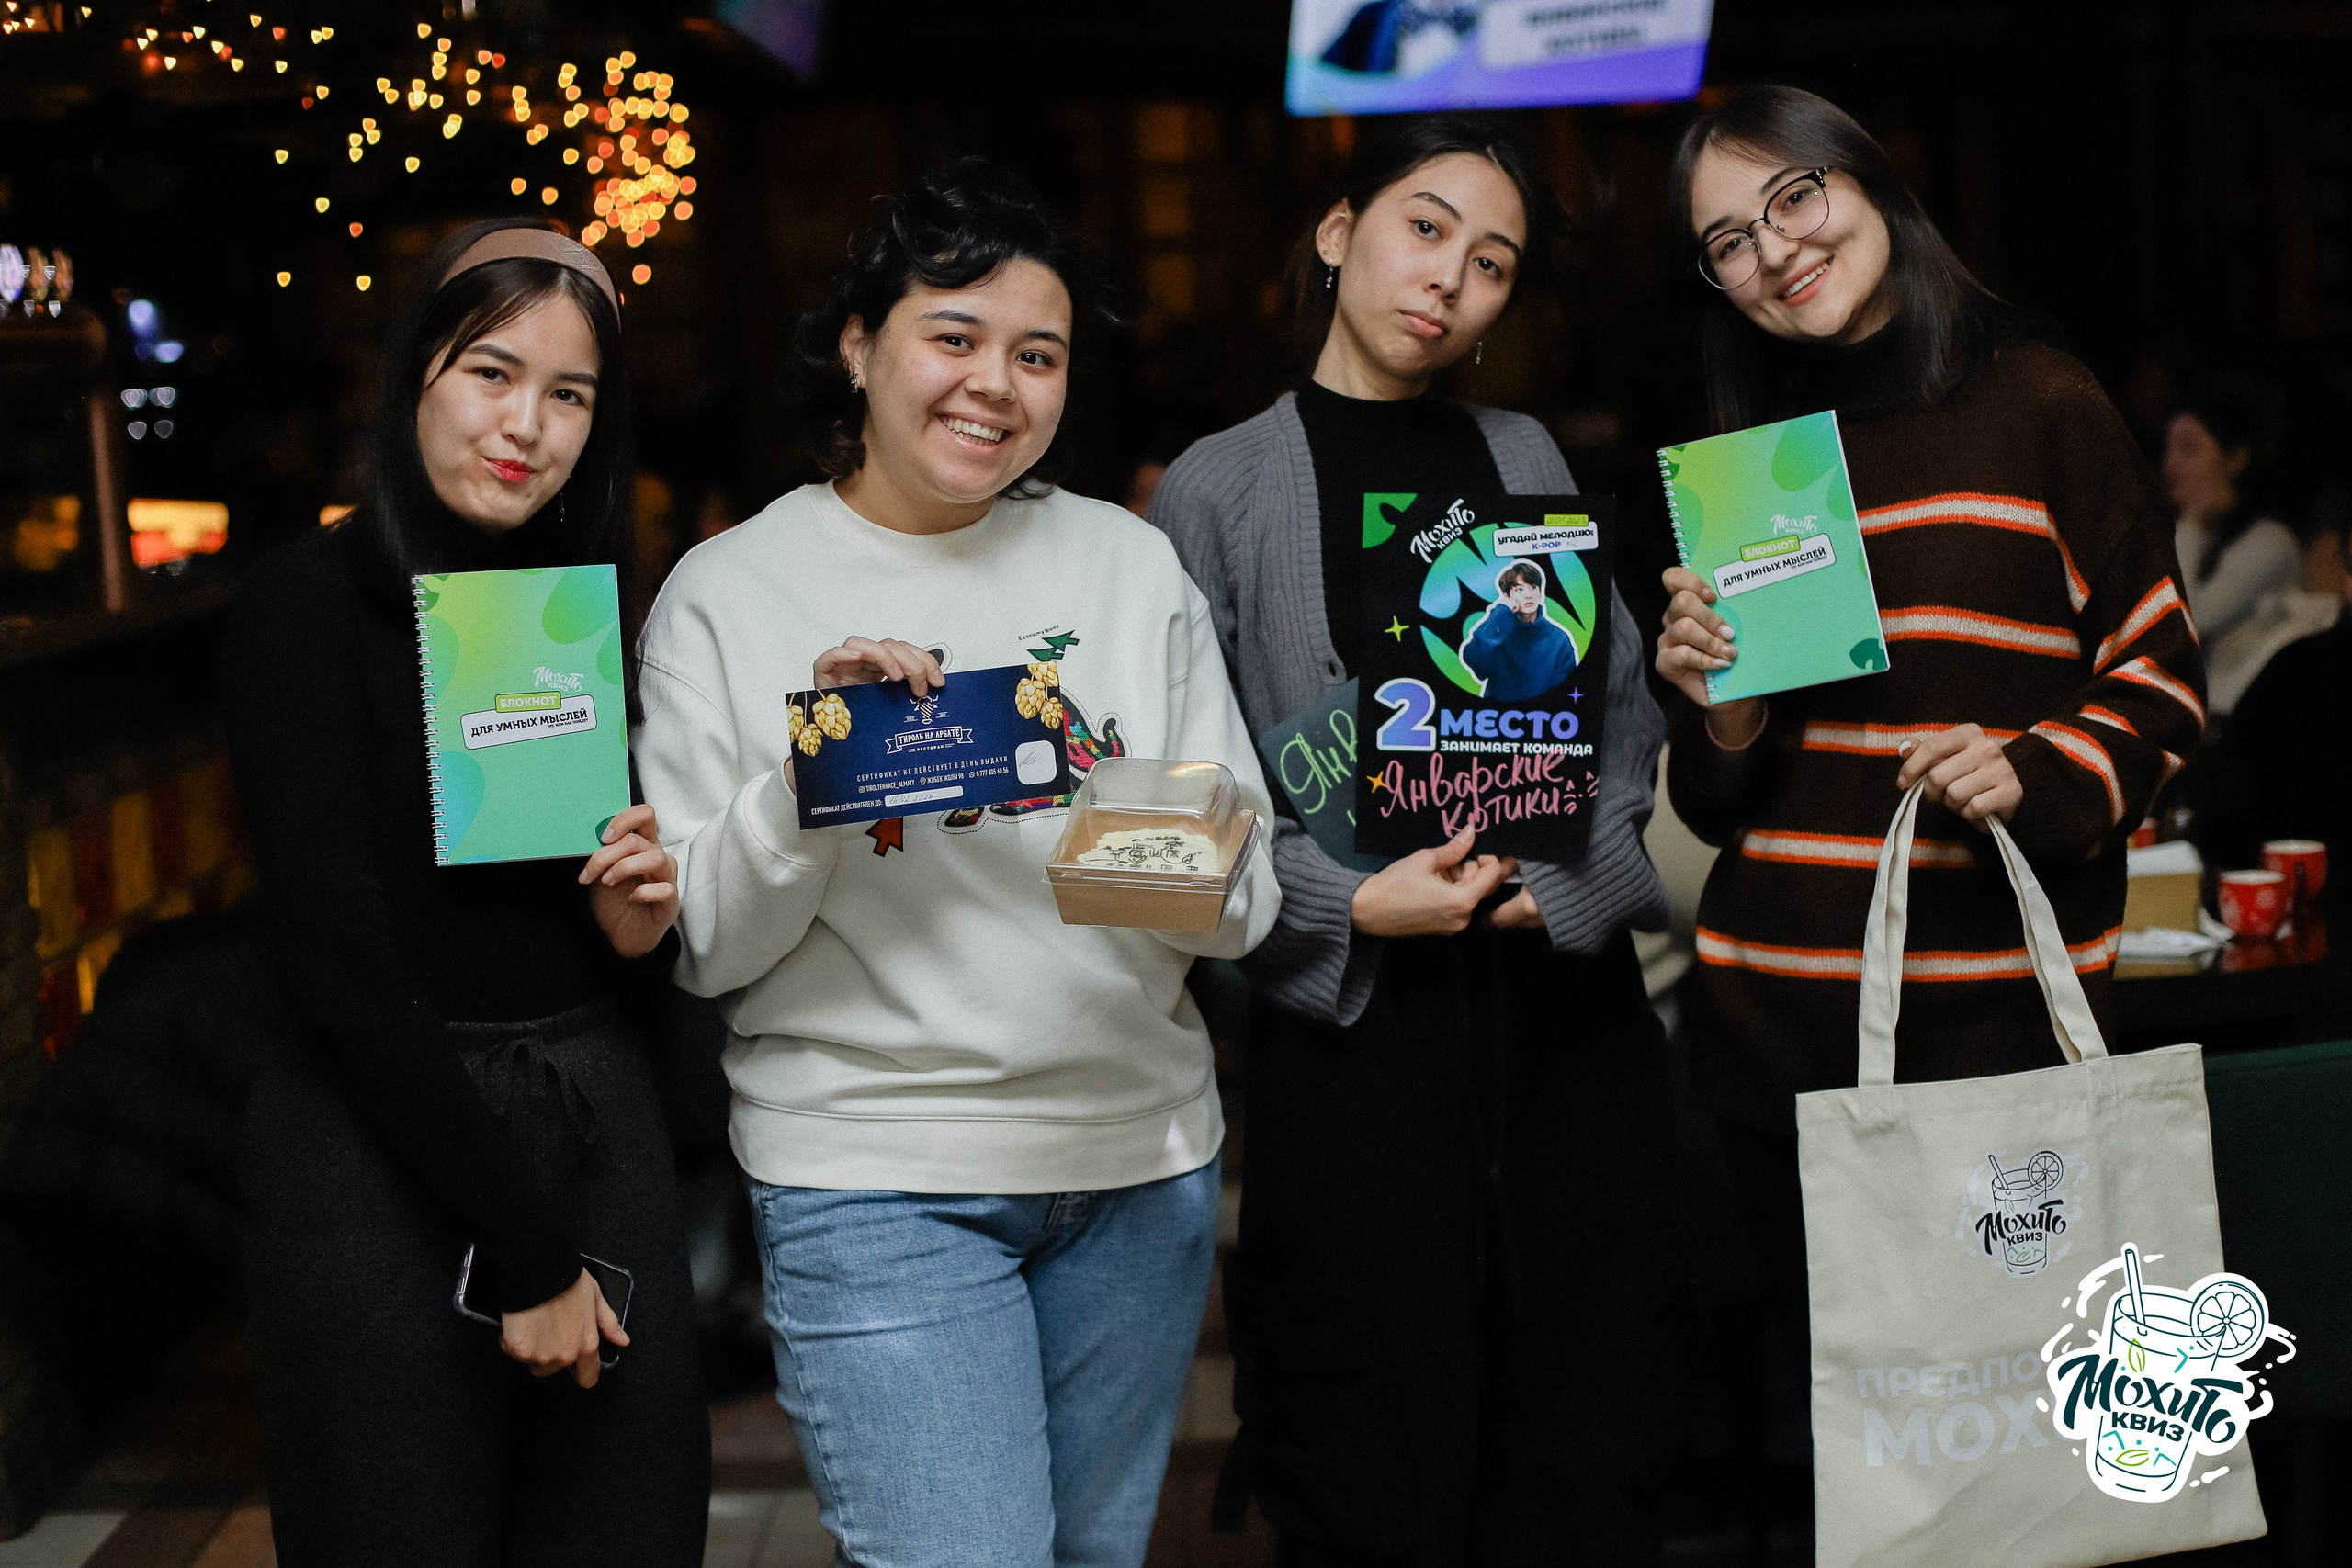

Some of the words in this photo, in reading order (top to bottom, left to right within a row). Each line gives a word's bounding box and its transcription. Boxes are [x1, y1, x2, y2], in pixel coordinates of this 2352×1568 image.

[1498, 533, 1537, 545] УГАДАЙ
[1540, 529, 1594, 540] МЕЛОДИЮ:
[1532, 541, 1561, 549] K-POP
[1744, 539, 1795, 558] БЛОКНОТ
[1723, 573, 1744, 588] ДЛЯ
[1744, 561, 1781, 580] УМНЫХ
[1782, 547, 1826, 568] МЫСЛЕЙ
[499, 696, 557, 708] БЛОКНОТ
[471, 724, 493, 737] ДЛЯ
[496, 717, 537, 732] УМНЫХ
[540, 708, 588, 725] МЫСЛЕЙ
[1374, 677, 1437, 752] 2
[1440, 708, 1579, 739] МЕСТО
[898, 733, 924, 744] ТИРОЛЬ
[935, 728, 960, 738] АРБАТЕ
[1440, 740, 1520, 754] ЗАНИМАЕТ
[1522, 742, 1593, 757] КОМАНДА
[857, 770, 900, 782] СЕРТИФИКАТ
[903, 768, 911, 776] НЕ
[914, 762, 952, 775] ДЕЙСТВУЕТ
[961, 759, 978, 768] ДЕНЬ
[980, 756, 1008, 765] ВЫДАЧИ
[927, 775, 943, 784] ЖИБЕК
[1381, 749, 1566, 823] Январские
[811, 805, 840, 815] СЕРТИФИКАТ
[841, 799, 875, 812] ДЕЙСТВИТЕЛЕН
[1856, 1351, 2045, 1402] ПРЕДПО
[1863, 1388, 2051, 1467] МОХ
